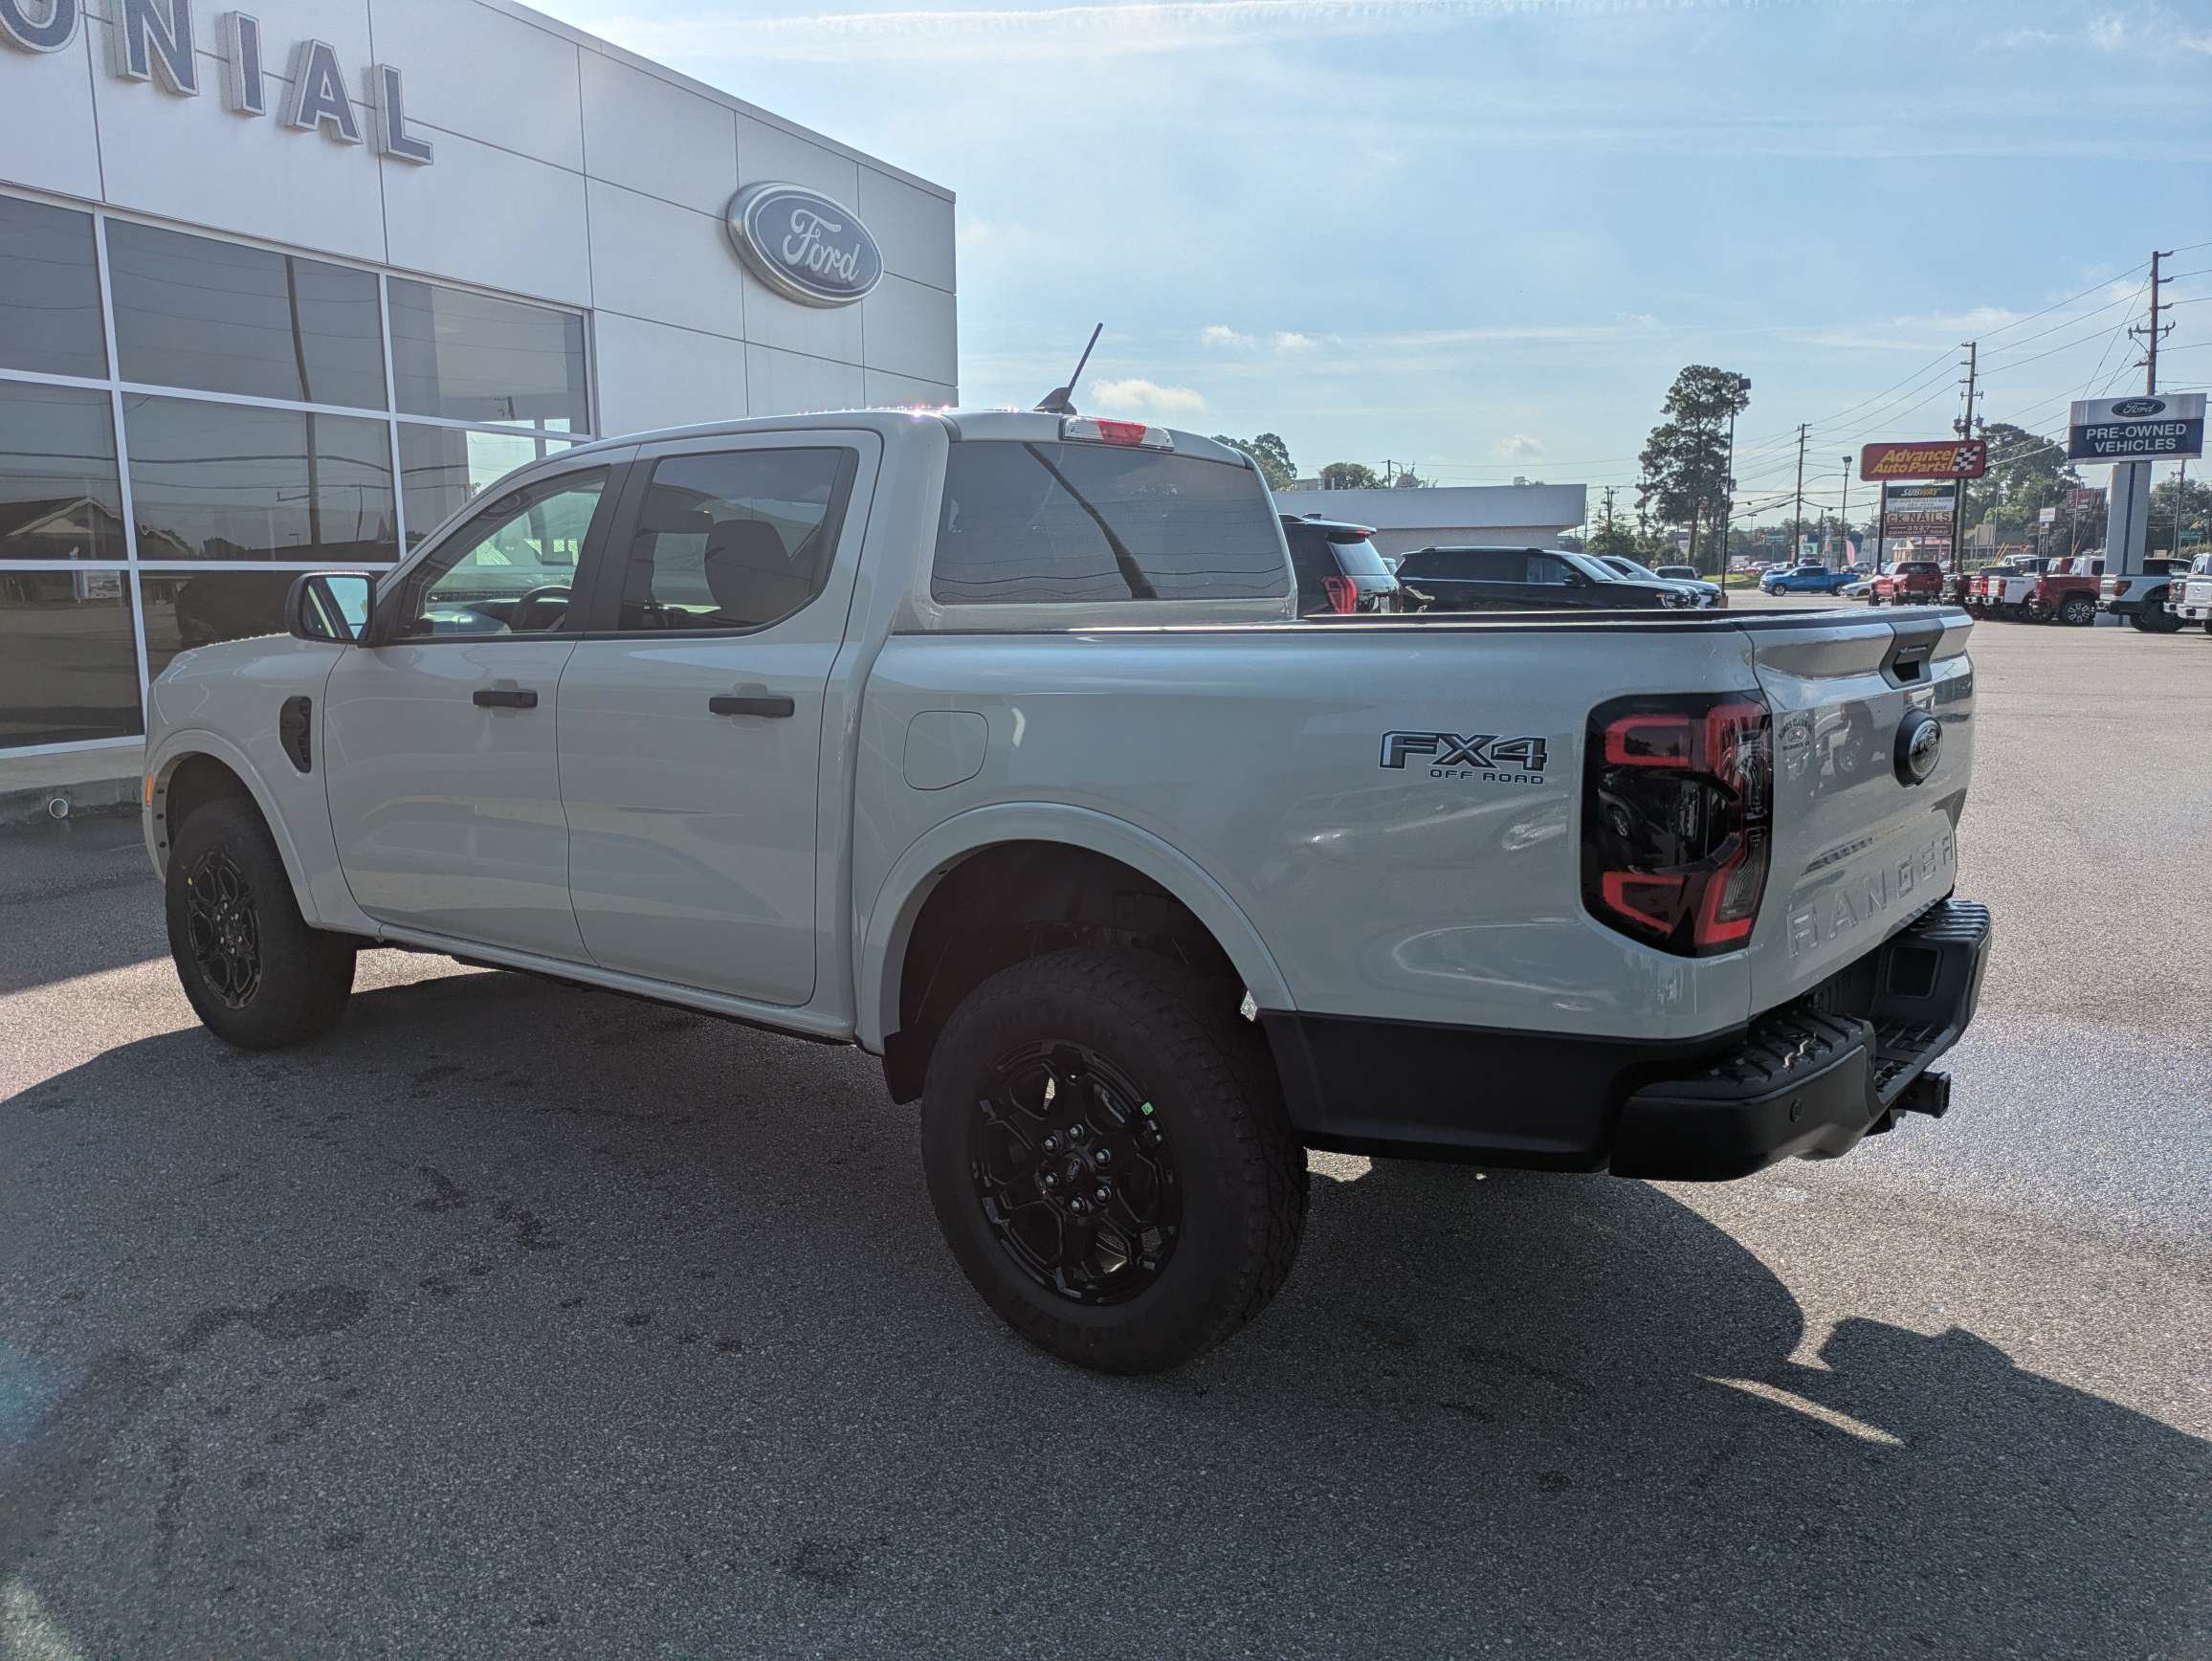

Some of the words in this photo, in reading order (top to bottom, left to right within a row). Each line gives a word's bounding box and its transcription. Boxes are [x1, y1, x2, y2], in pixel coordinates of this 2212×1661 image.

[783, 209, 860, 282] Ford
[2123, 402, 2157, 414] Ford
[2086, 423, 2187, 440] PRE-OWNED
[2094, 437, 2177, 453] VEHICLES
[1880, 448, 1953, 464] Advance
[1870, 462, 1908, 474] Auto
[1908, 461, 1948, 473] Parts
[1900, 488, 1939, 497] SUBWAY
[1909, 512, 1950, 522] NAILS
[1378, 730, 1548, 773] FX4
[1429, 768, 1473, 780] OFF
[1483, 772, 1545, 786] ROAD
[1786, 829, 1954, 958] RANGER
